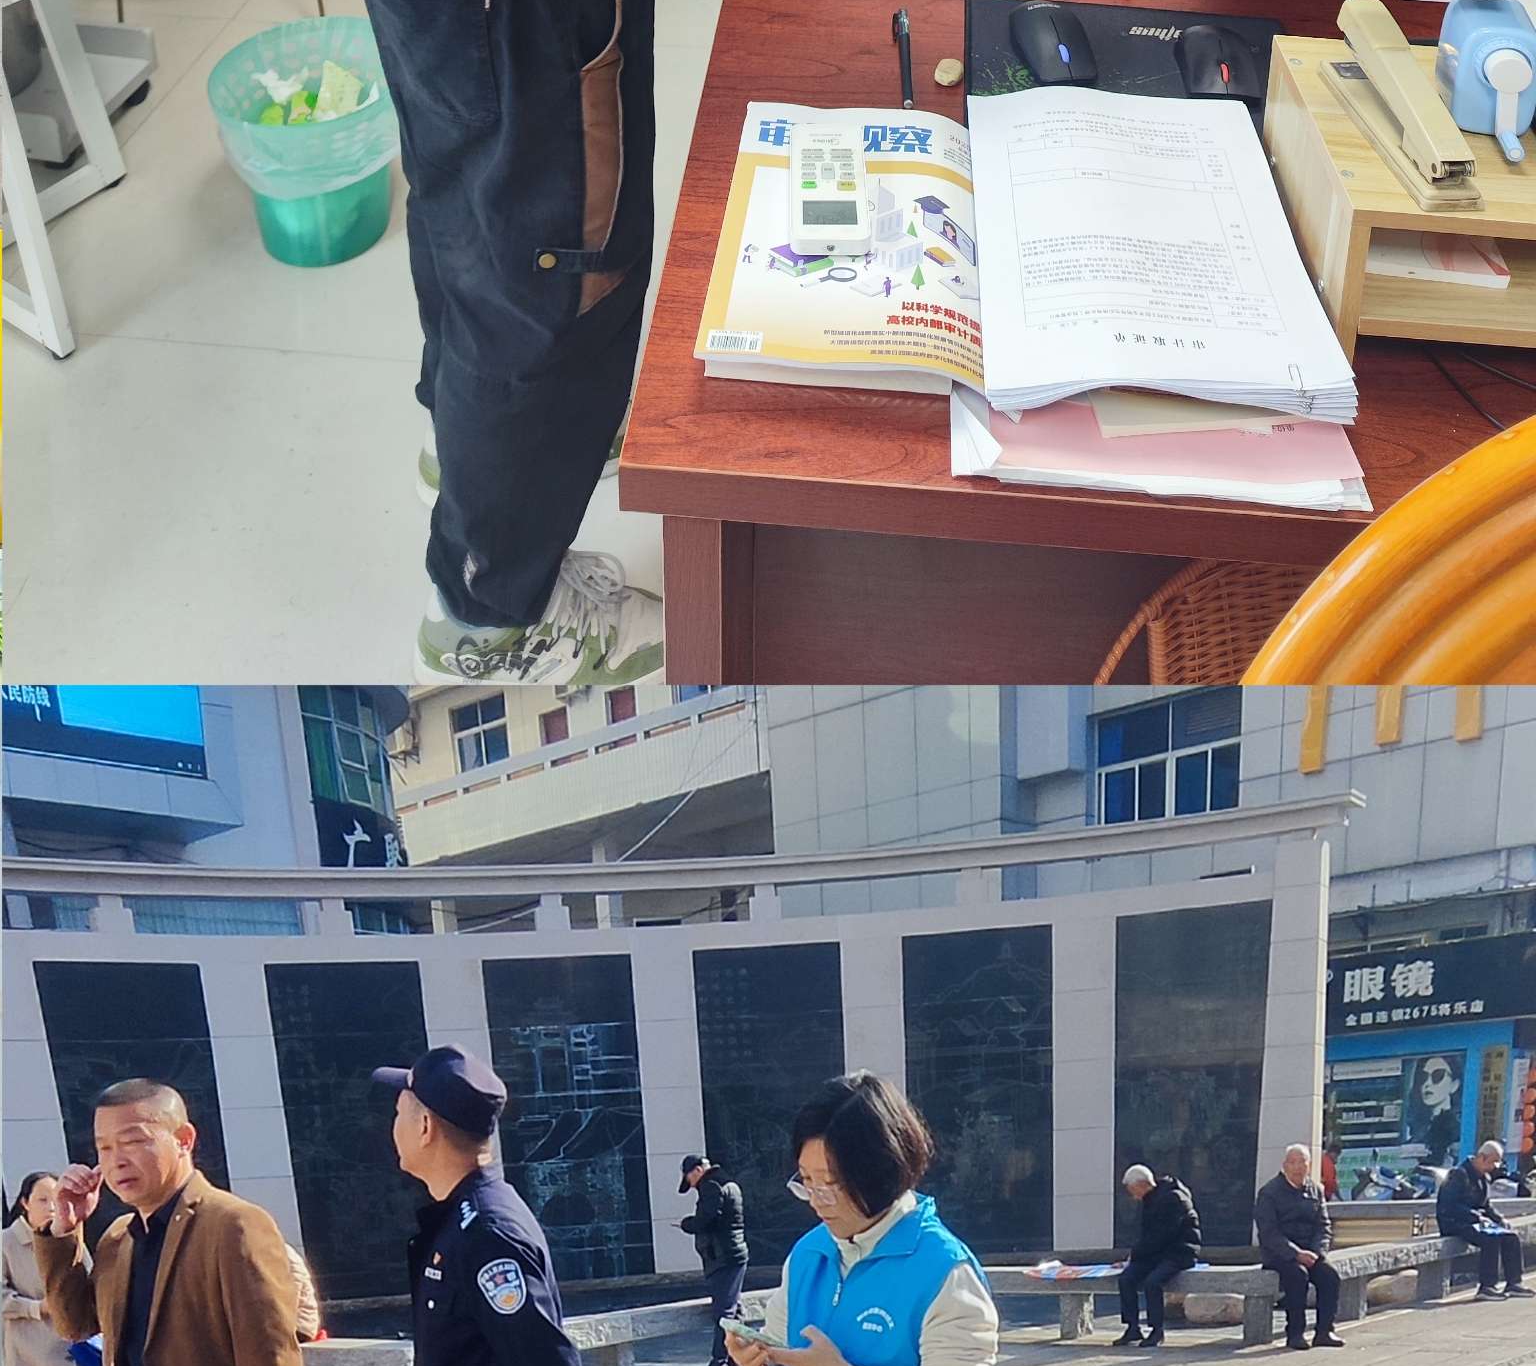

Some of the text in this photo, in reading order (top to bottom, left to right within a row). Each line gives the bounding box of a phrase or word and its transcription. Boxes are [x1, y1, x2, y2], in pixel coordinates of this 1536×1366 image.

[758, 119, 933, 154] 审观察
[1343, 960, 1436, 1003] 眼镜
